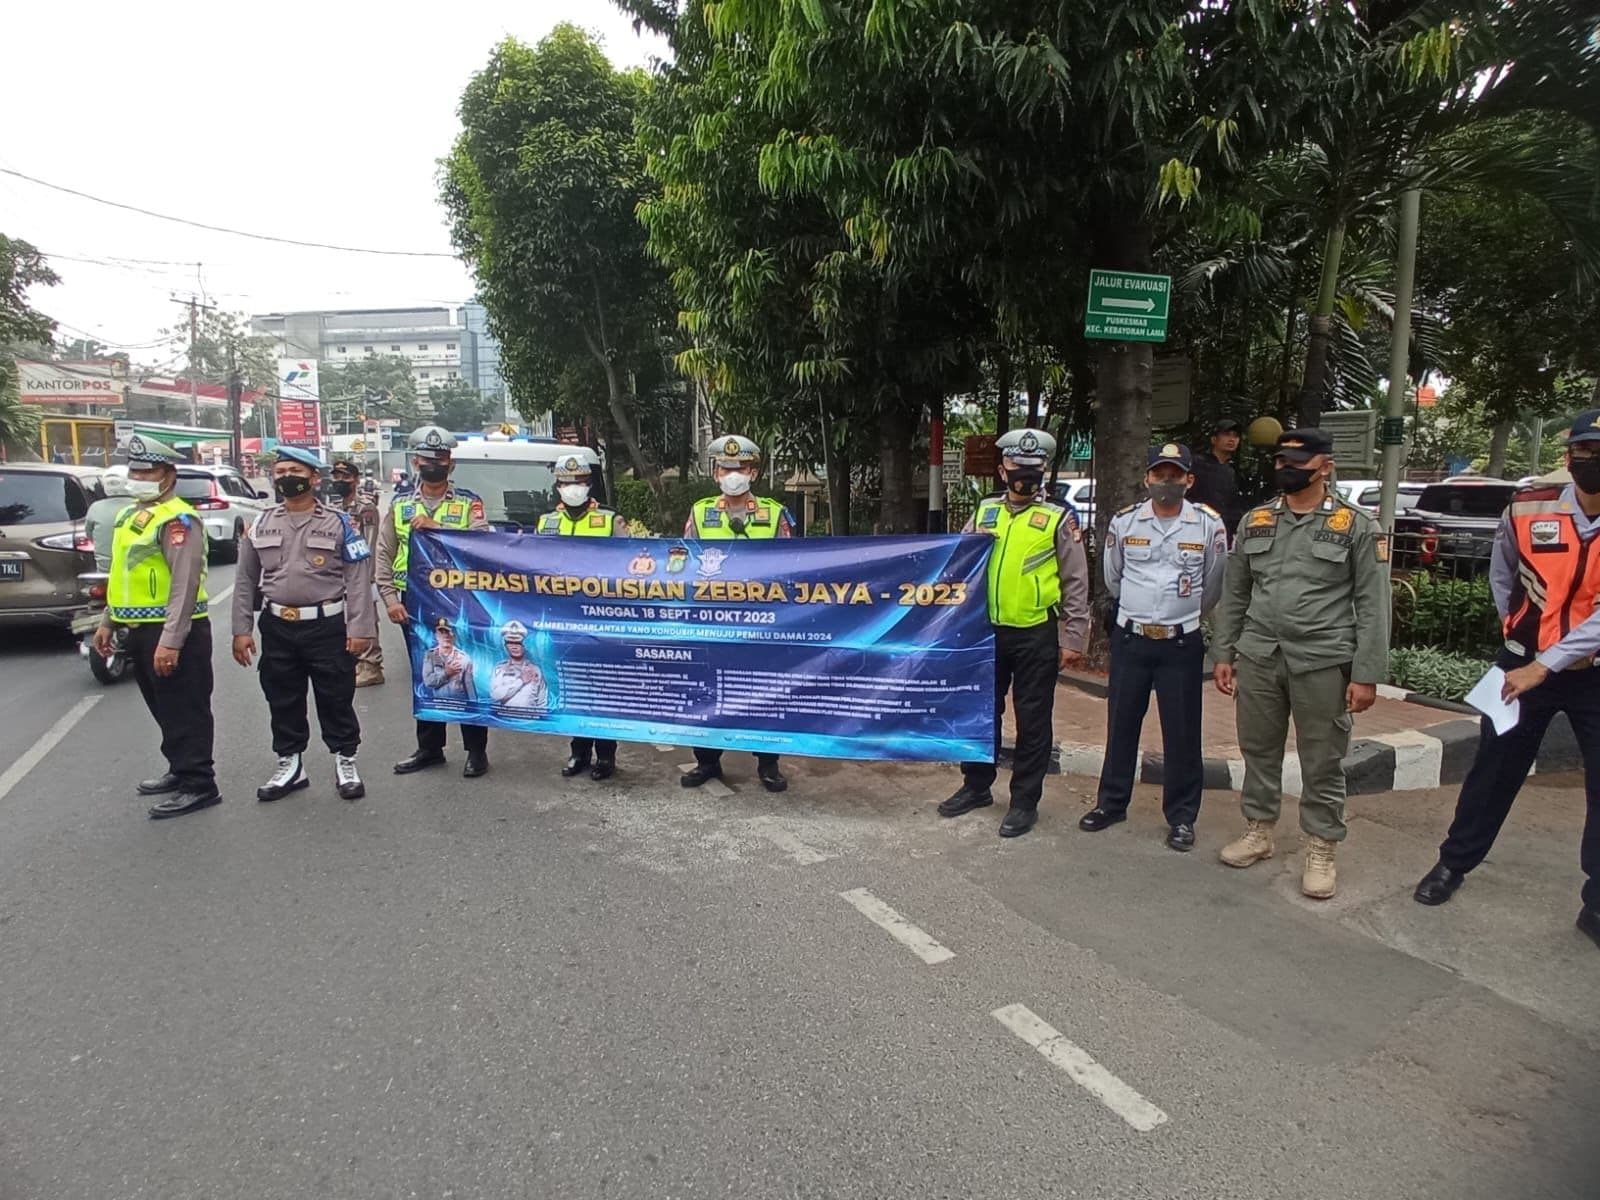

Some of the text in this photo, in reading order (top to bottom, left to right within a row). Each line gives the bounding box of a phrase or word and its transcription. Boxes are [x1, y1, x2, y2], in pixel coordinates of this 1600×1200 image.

[1094, 276, 1168, 292] JALUR EVAKUASI
[428, 569, 530, 593] OPERASI
[534, 576, 685, 600] KEPOLISIAN
[692, 580, 788, 603] ZEBRA
[794, 581, 873, 605] JAYA
[898, 582, 967, 606] 2023
[581, 605, 639, 618] TANGGAL
[642, 608, 655, 619] 18
[659, 608, 691, 620] SEPT
[714, 610, 743, 622] OKT
[743, 612, 776, 624] 2023
[696, 630, 735, 638] MENUJU
[736, 631, 772, 640] PEMILU
[773, 632, 806, 641] DAMAI
[807, 633, 833, 641] 2024
[635, 648, 692, 661] SASARAN
